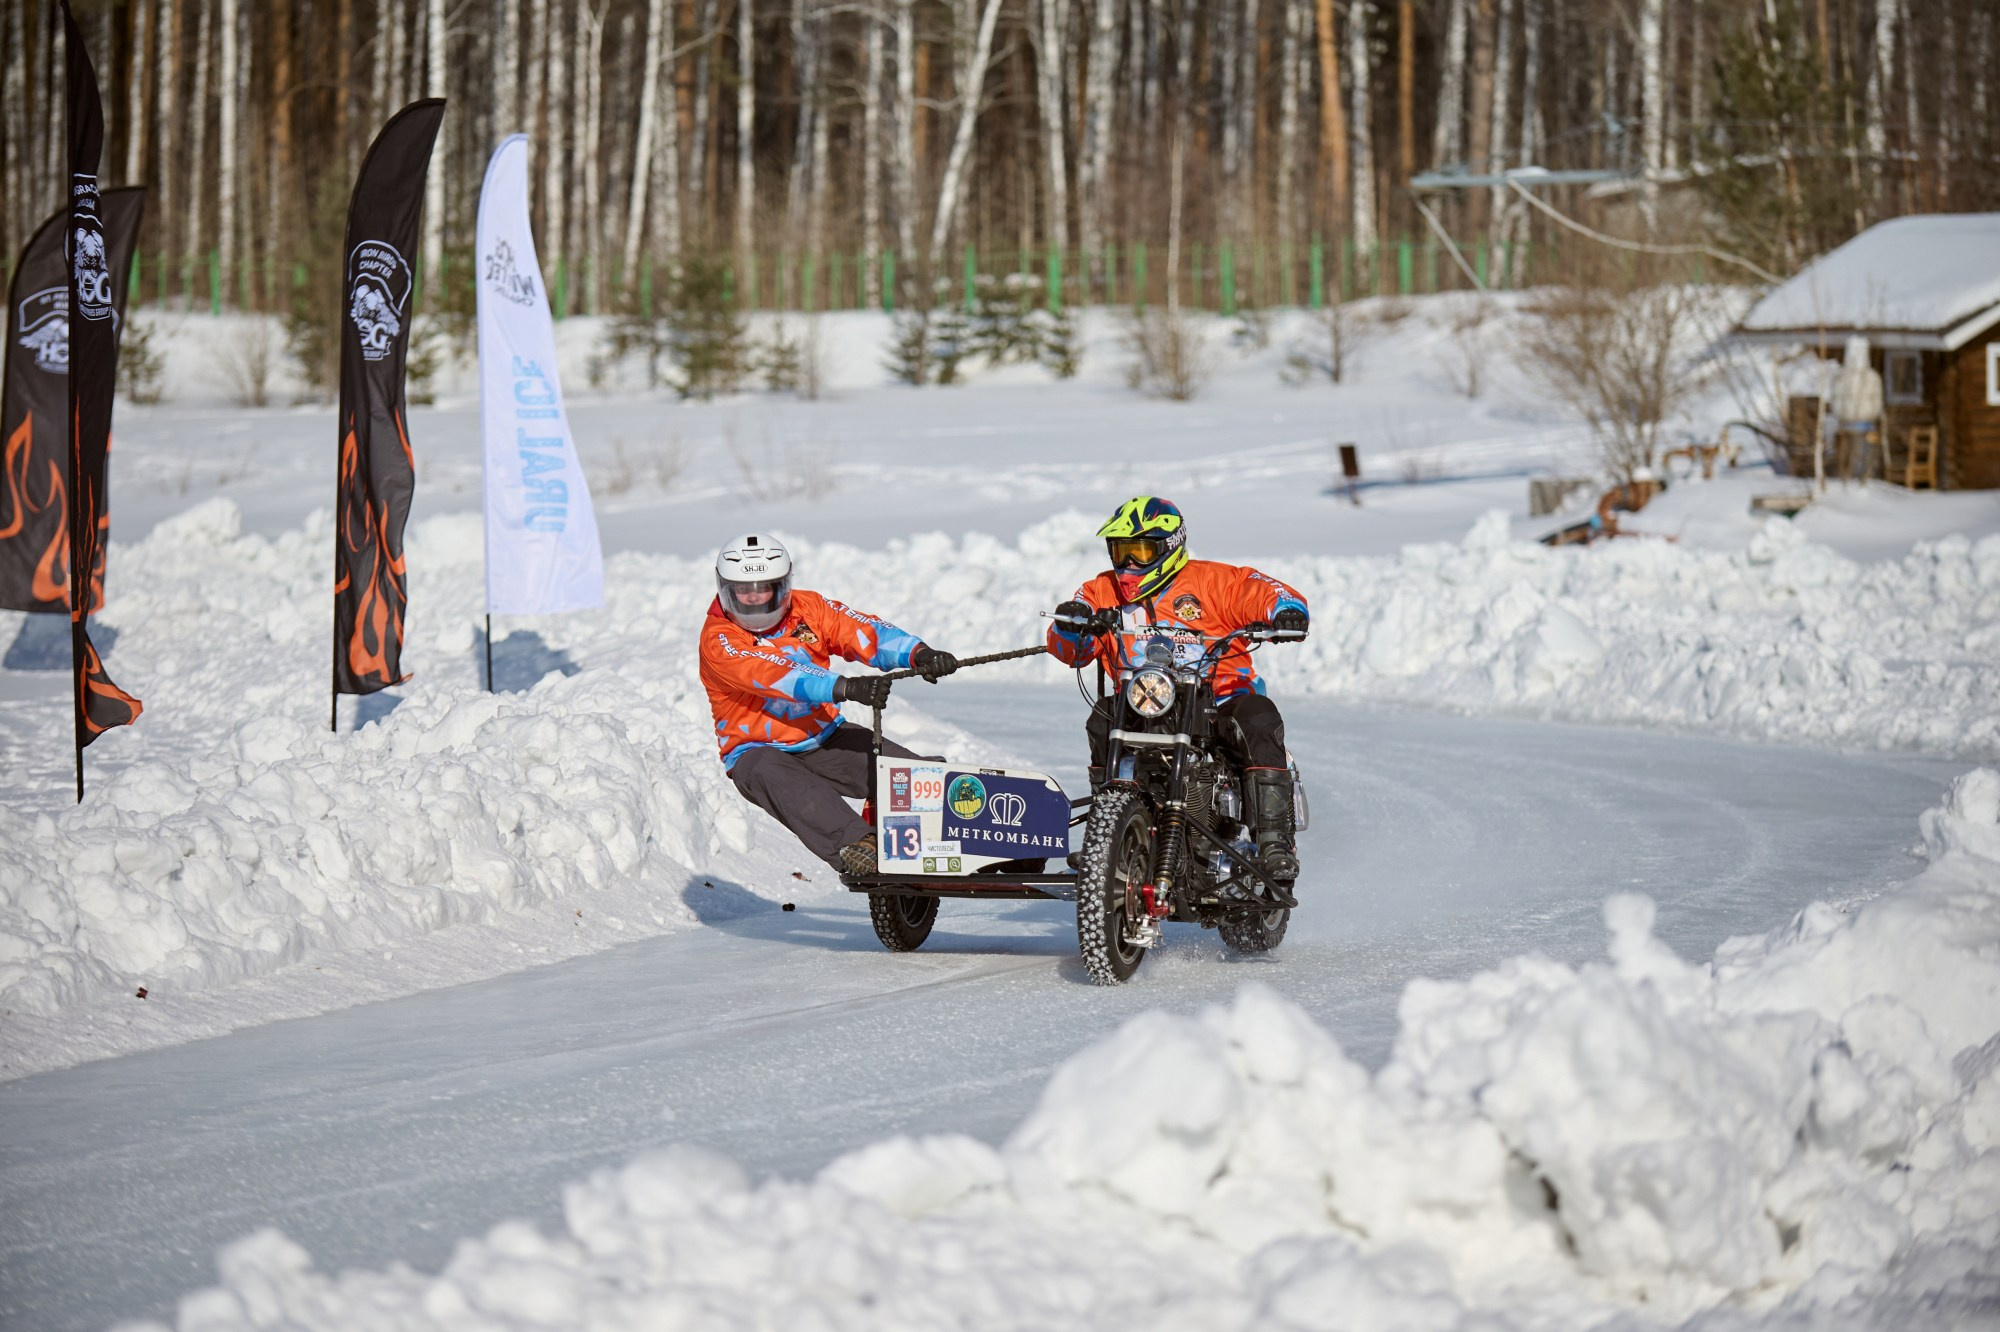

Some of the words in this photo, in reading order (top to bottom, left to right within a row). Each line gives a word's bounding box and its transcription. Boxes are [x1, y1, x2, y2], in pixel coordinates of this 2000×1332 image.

[914, 781, 942, 799] 999
[888, 828, 920, 857] 13
[947, 826, 1064, 849] МЕТКОМБАНК
